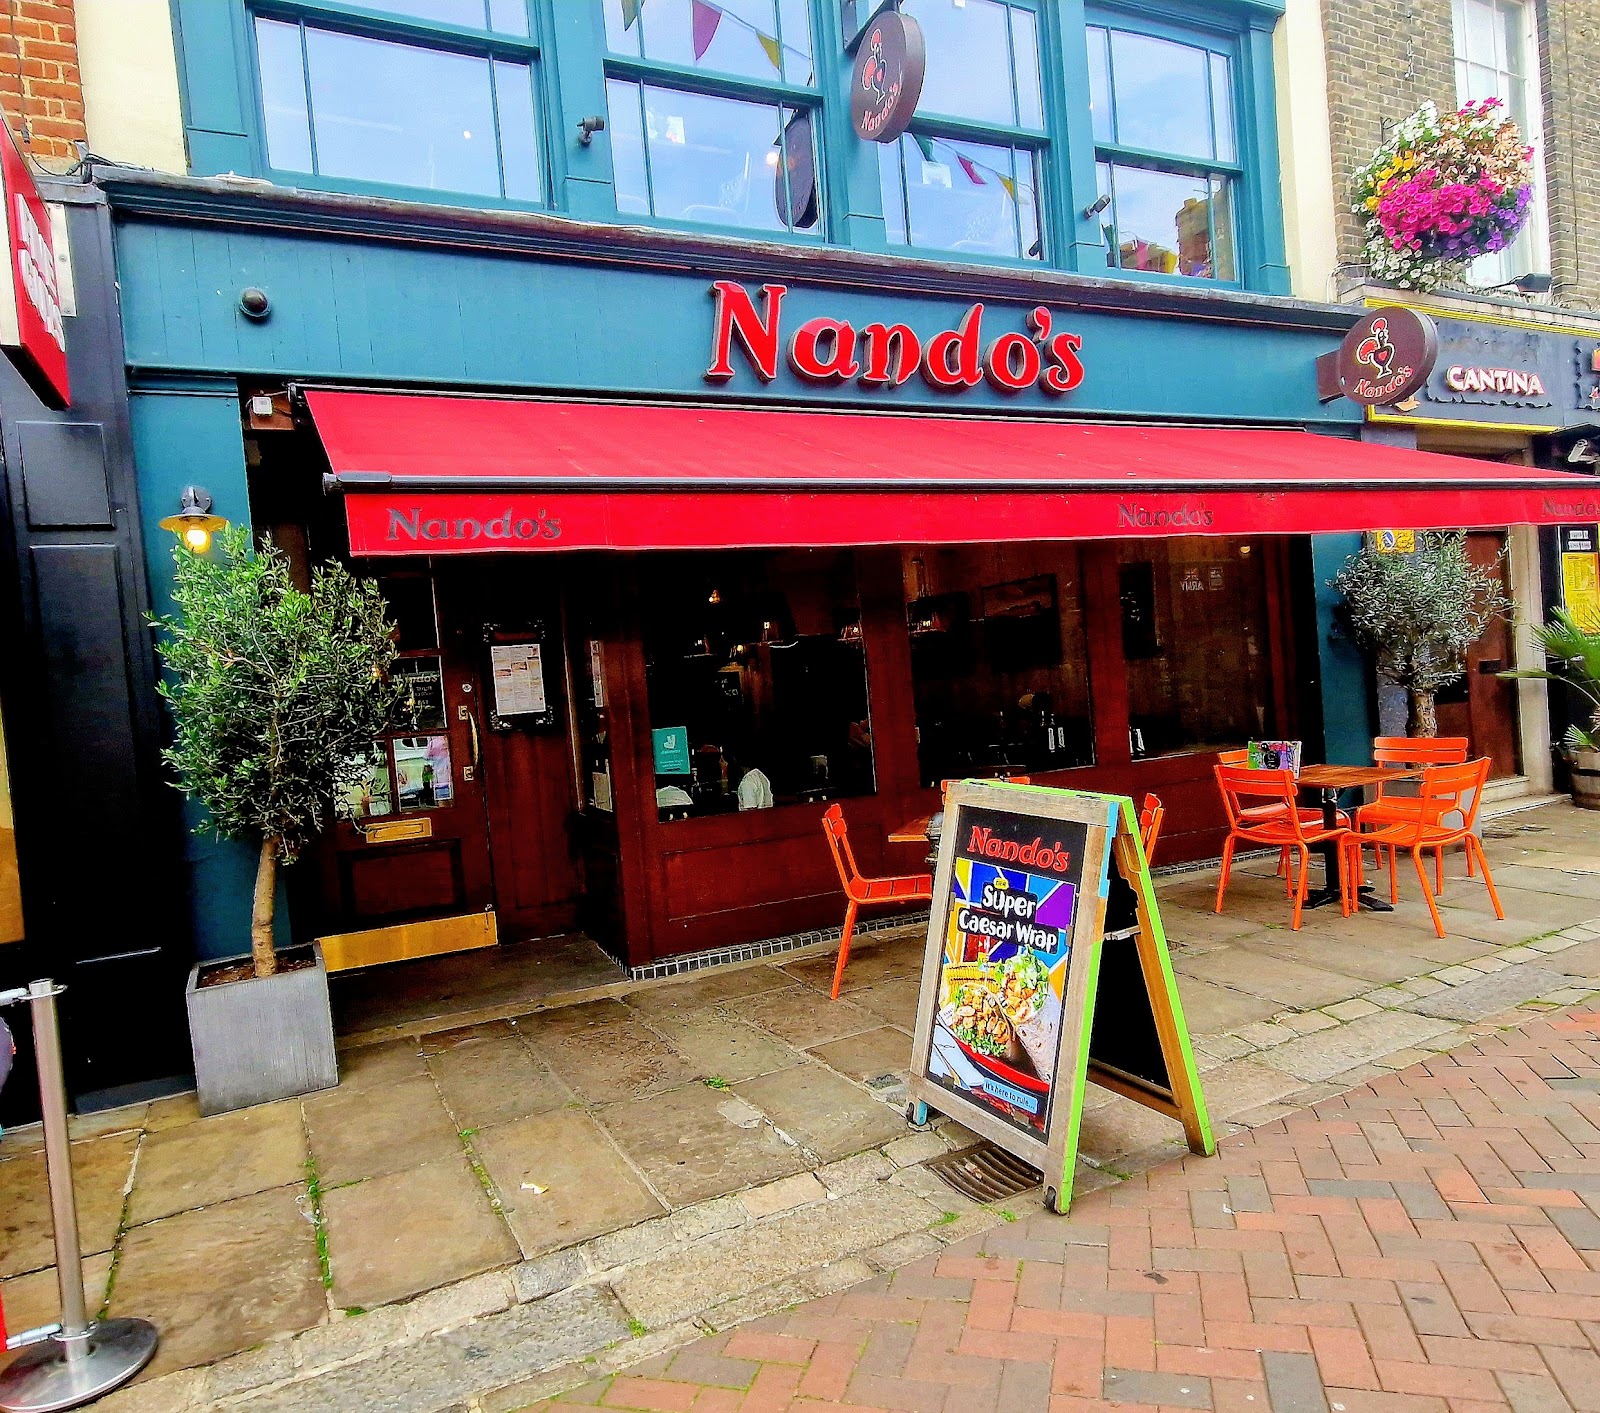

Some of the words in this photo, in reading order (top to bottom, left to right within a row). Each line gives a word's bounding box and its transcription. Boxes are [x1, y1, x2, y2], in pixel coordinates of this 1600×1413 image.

[861, 82, 900, 131] Nando's
[704, 279, 1086, 393] Nando's
[1353, 364, 1414, 398] Nando's
[1445, 365, 1546, 395] CANTINA
[386, 507, 562, 540] Nando's
[1117, 501, 1213, 527] Nando's
[966, 825, 1070, 872] Nando's
[983, 885, 1036, 918] Super
[959, 909, 1015, 940] Caesar
[1016, 920, 1057, 953] Wrap
[994, 1085, 1008, 1098] here
[1009, 1092, 1016, 1101] to
